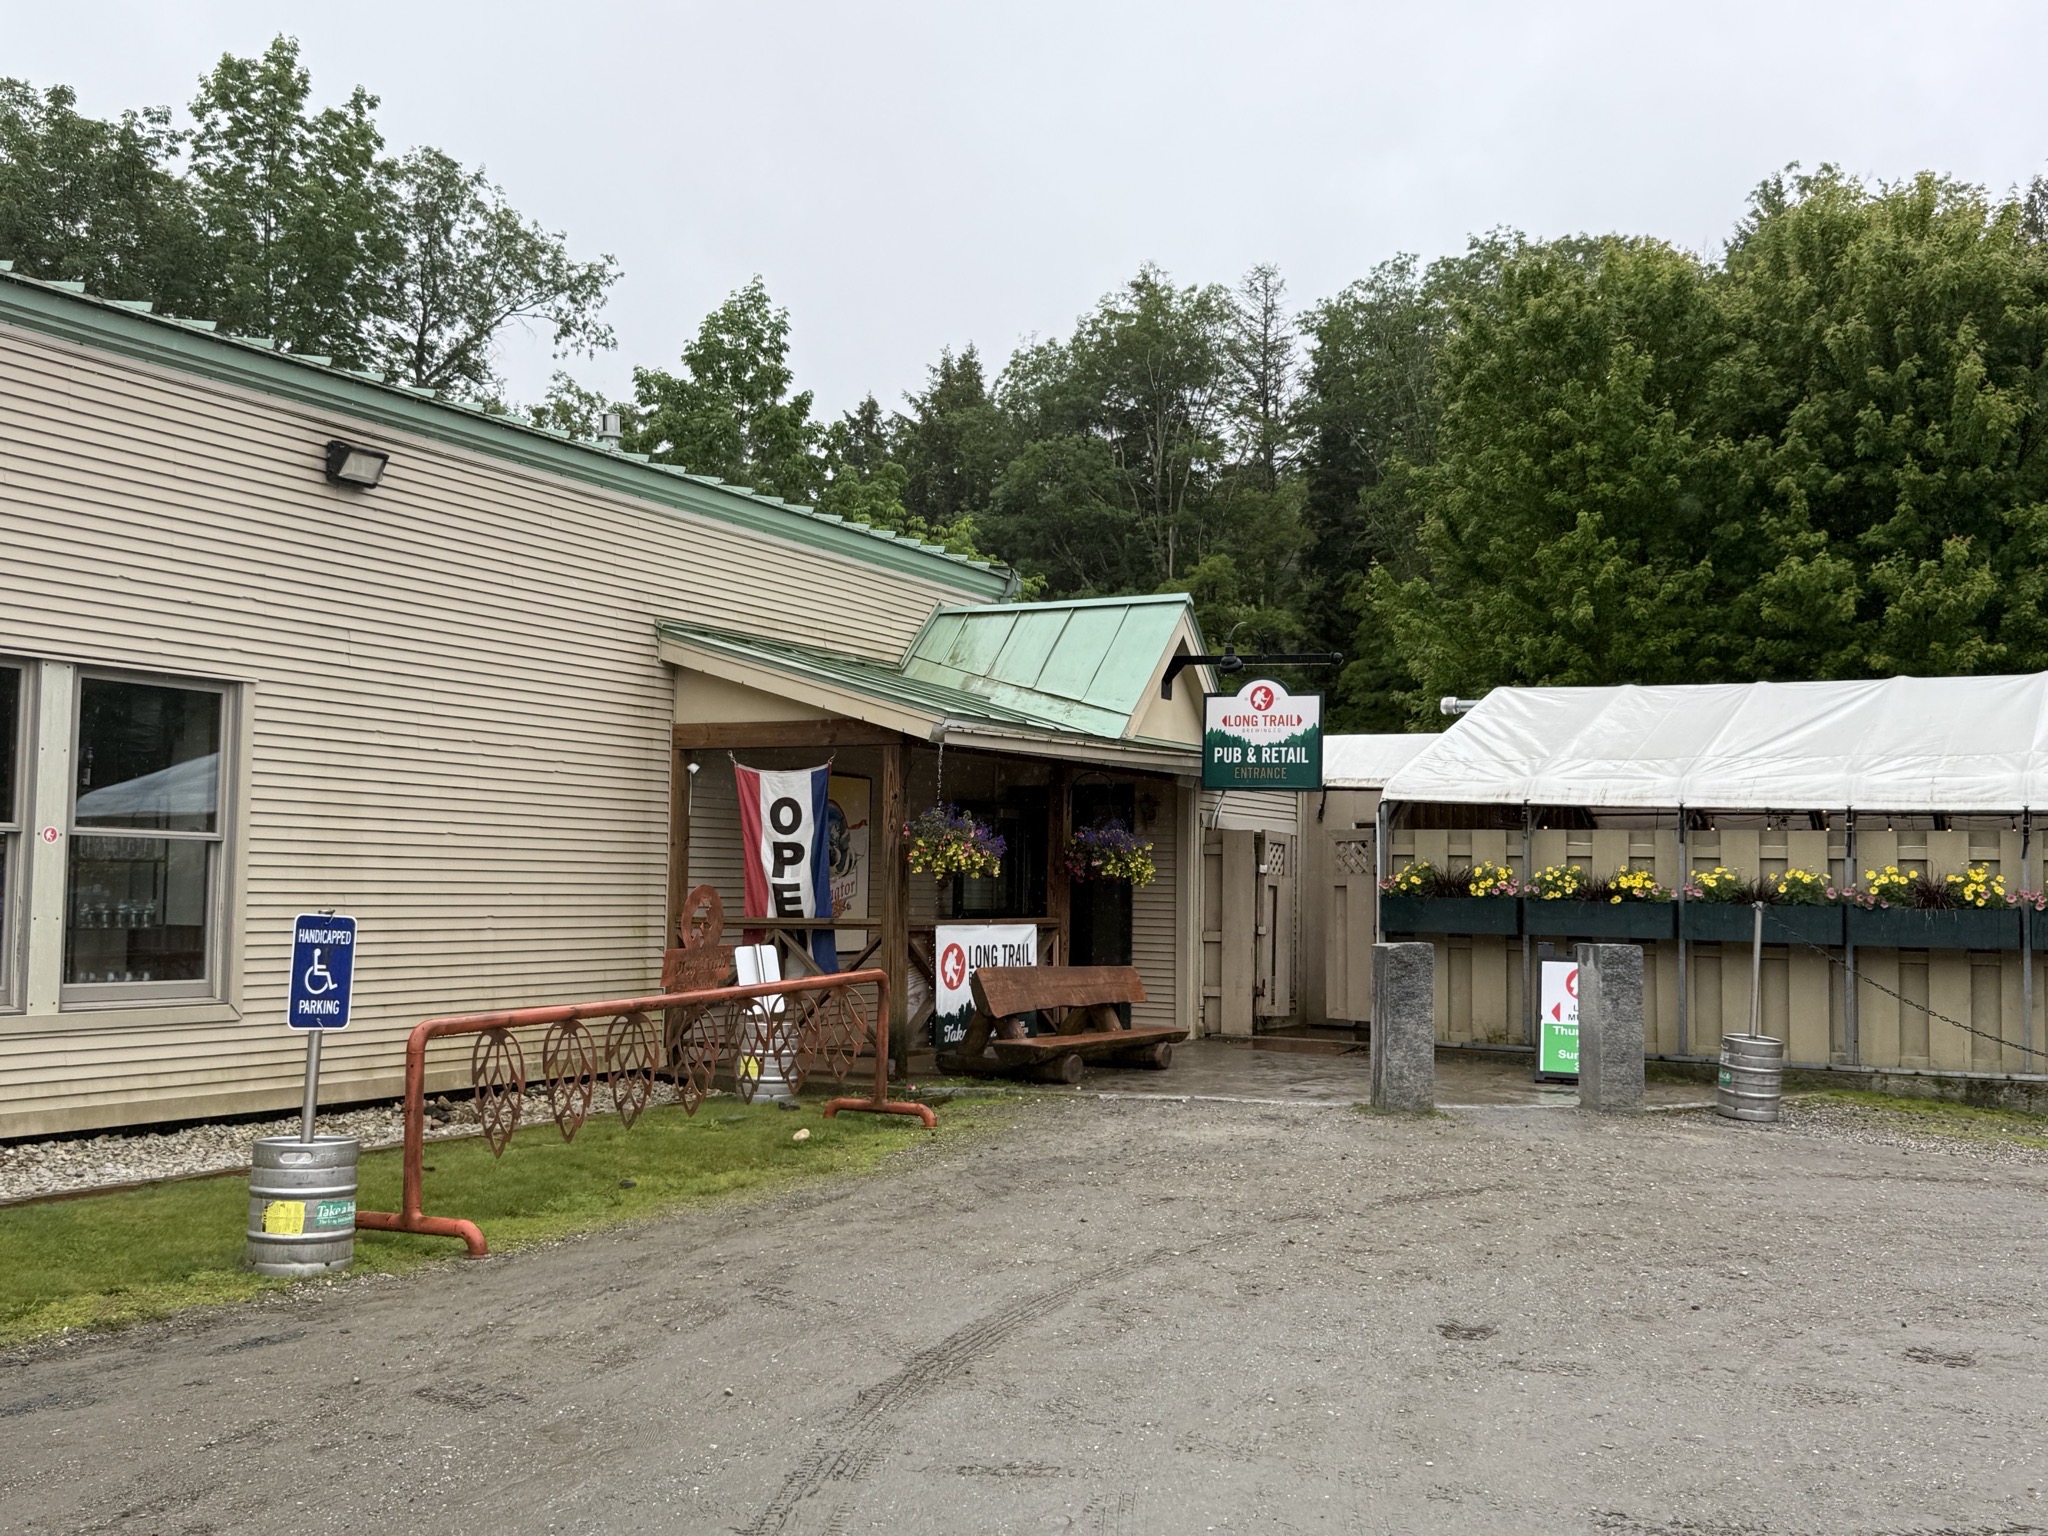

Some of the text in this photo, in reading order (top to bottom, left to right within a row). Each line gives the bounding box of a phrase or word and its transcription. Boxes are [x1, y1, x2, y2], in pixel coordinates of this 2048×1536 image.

[1228, 714, 1296, 727] LONG TRAIL
[1214, 747, 1309, 763] PUB & RETAIL
[1234, 767, 1287, 779] ENTRANCE
[298, 928, 352, 945] HANDICAPPED
[968, 943, 1032, 969] LONG TRAIL
[298, 999, 340, 1015] PARKING
[944, 1023, 968, 1043] Tak
[317, 1205, 341, 1217] Take
